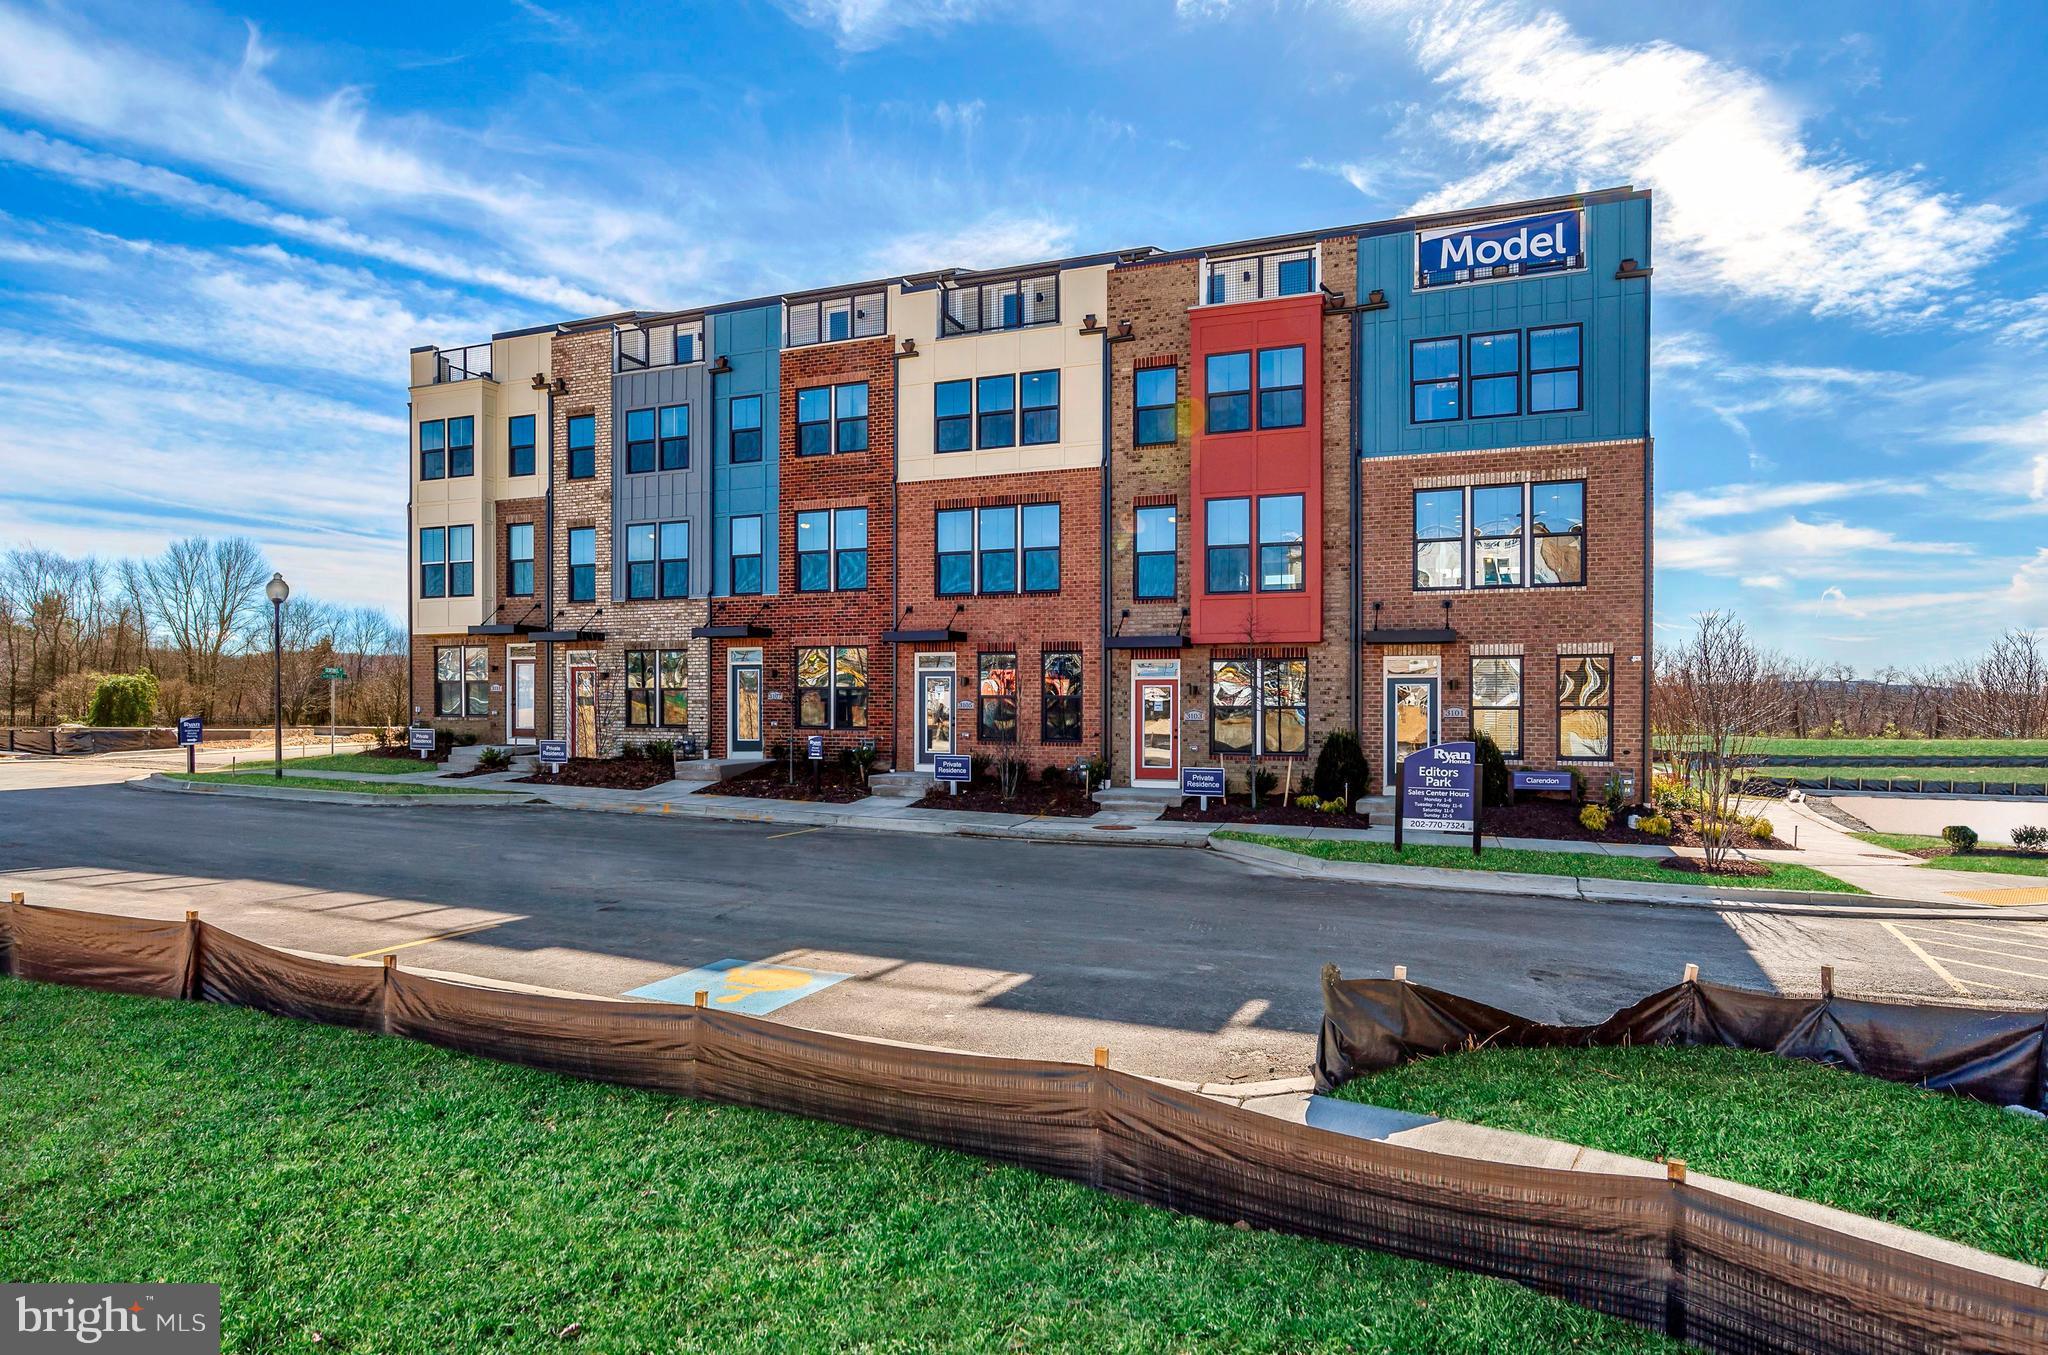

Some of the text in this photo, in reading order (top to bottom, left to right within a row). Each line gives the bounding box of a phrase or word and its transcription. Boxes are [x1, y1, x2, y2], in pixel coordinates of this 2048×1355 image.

[1440, 222, 1566, 269] Model
[1433, 748, 1471, 764] Ryan
[942, 760, 962, 768] Private
[938, 766, 967, 774] Residence
[1419, 766, 1459, 777] Editors
[1186, 780, 1220, 788] Residence
[1426, 777, 1452, 787] Park
[1525, 776, 1560, 784] Clarendon
[1425, 789, 1448, 797] Center
[1449, 790, 1470, 798] Hours
[1410, 820, 1465, 829] 202-770-7324
